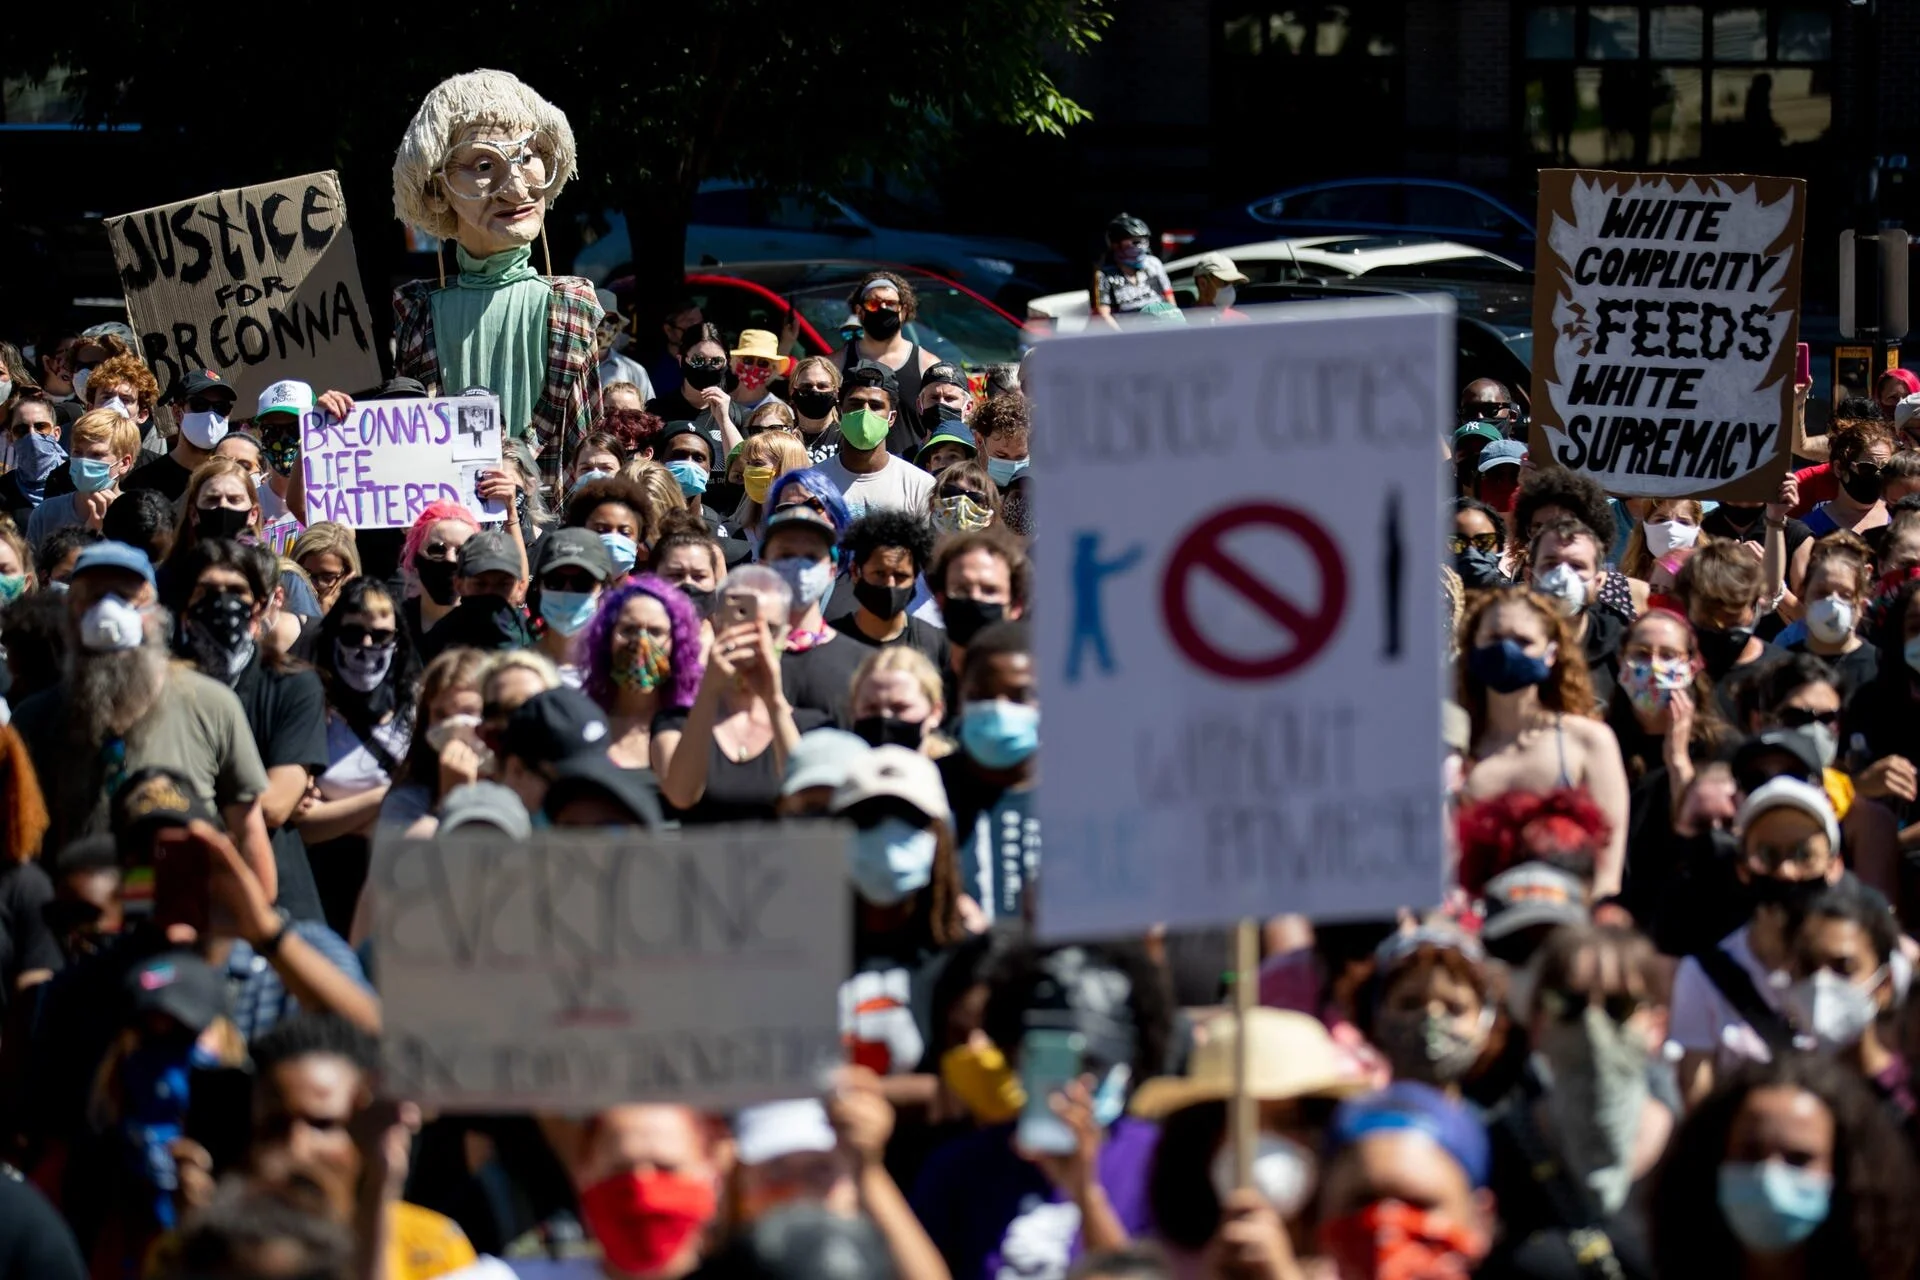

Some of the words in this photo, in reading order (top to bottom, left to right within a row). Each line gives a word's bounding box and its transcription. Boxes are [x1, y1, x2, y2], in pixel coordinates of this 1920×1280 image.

[112, 185, 336, 292] JUSTICE
[1598, 198, 1732, 242] WHITE
[1573, 246, 1779, 292] COMPLICITY
[214, 276, 296, 310] FOR
[141, 281, 370, 406] BREONNA
[1594, 298, 1776, 362] FEEDS
[1568, 364, 1705, 409] WHITE
[303, 402, 451, 450] BREONNA'S
[1558, 414, 1777, 480] SUPREMACY
[303, 450, 375, 490] LIFE
